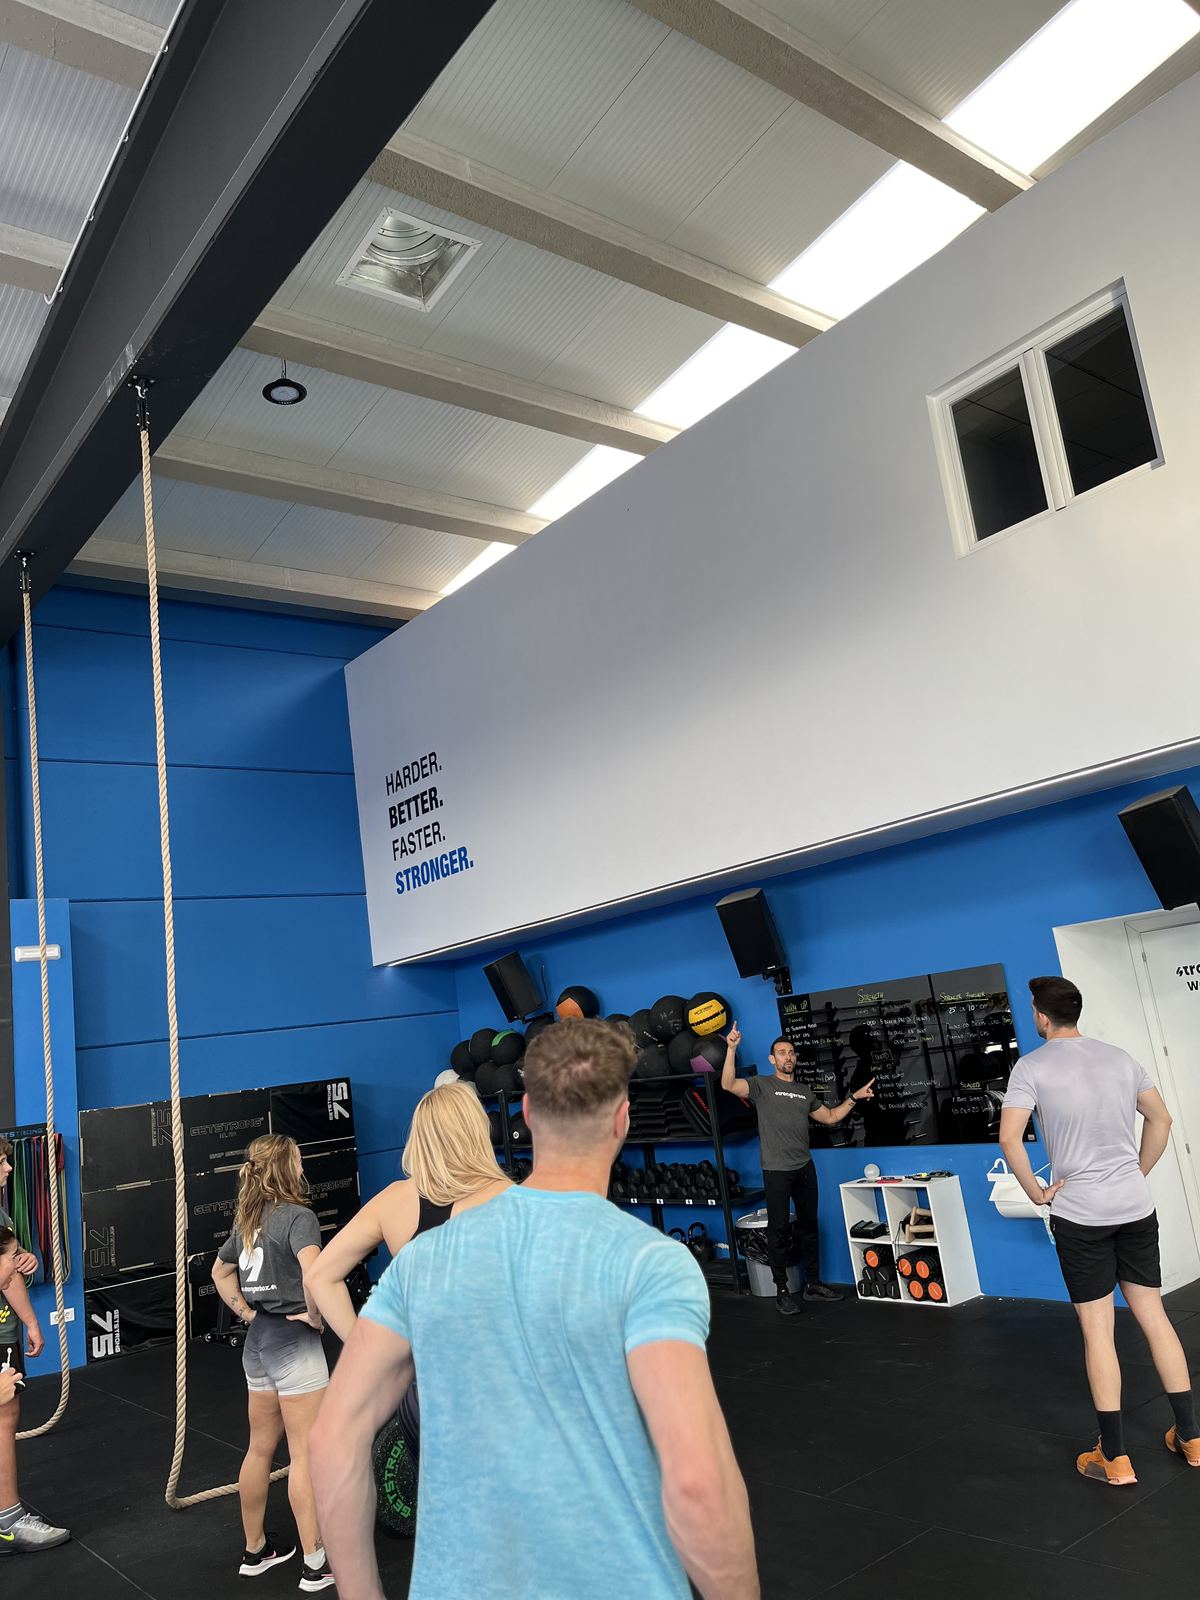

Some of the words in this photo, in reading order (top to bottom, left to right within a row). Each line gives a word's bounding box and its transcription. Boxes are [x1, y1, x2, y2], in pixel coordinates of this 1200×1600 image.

[385, 751, 442, 797] HARDER.
[388, 786, 444, 829] BETTER.
[392, 821, 446, 861] FASTER.
[395, 846, 474, 895] STRONGER.
[113, 1309, 121, 1354] GETSTRONG
[384, 1439, 412, 1518] GETSTRON
